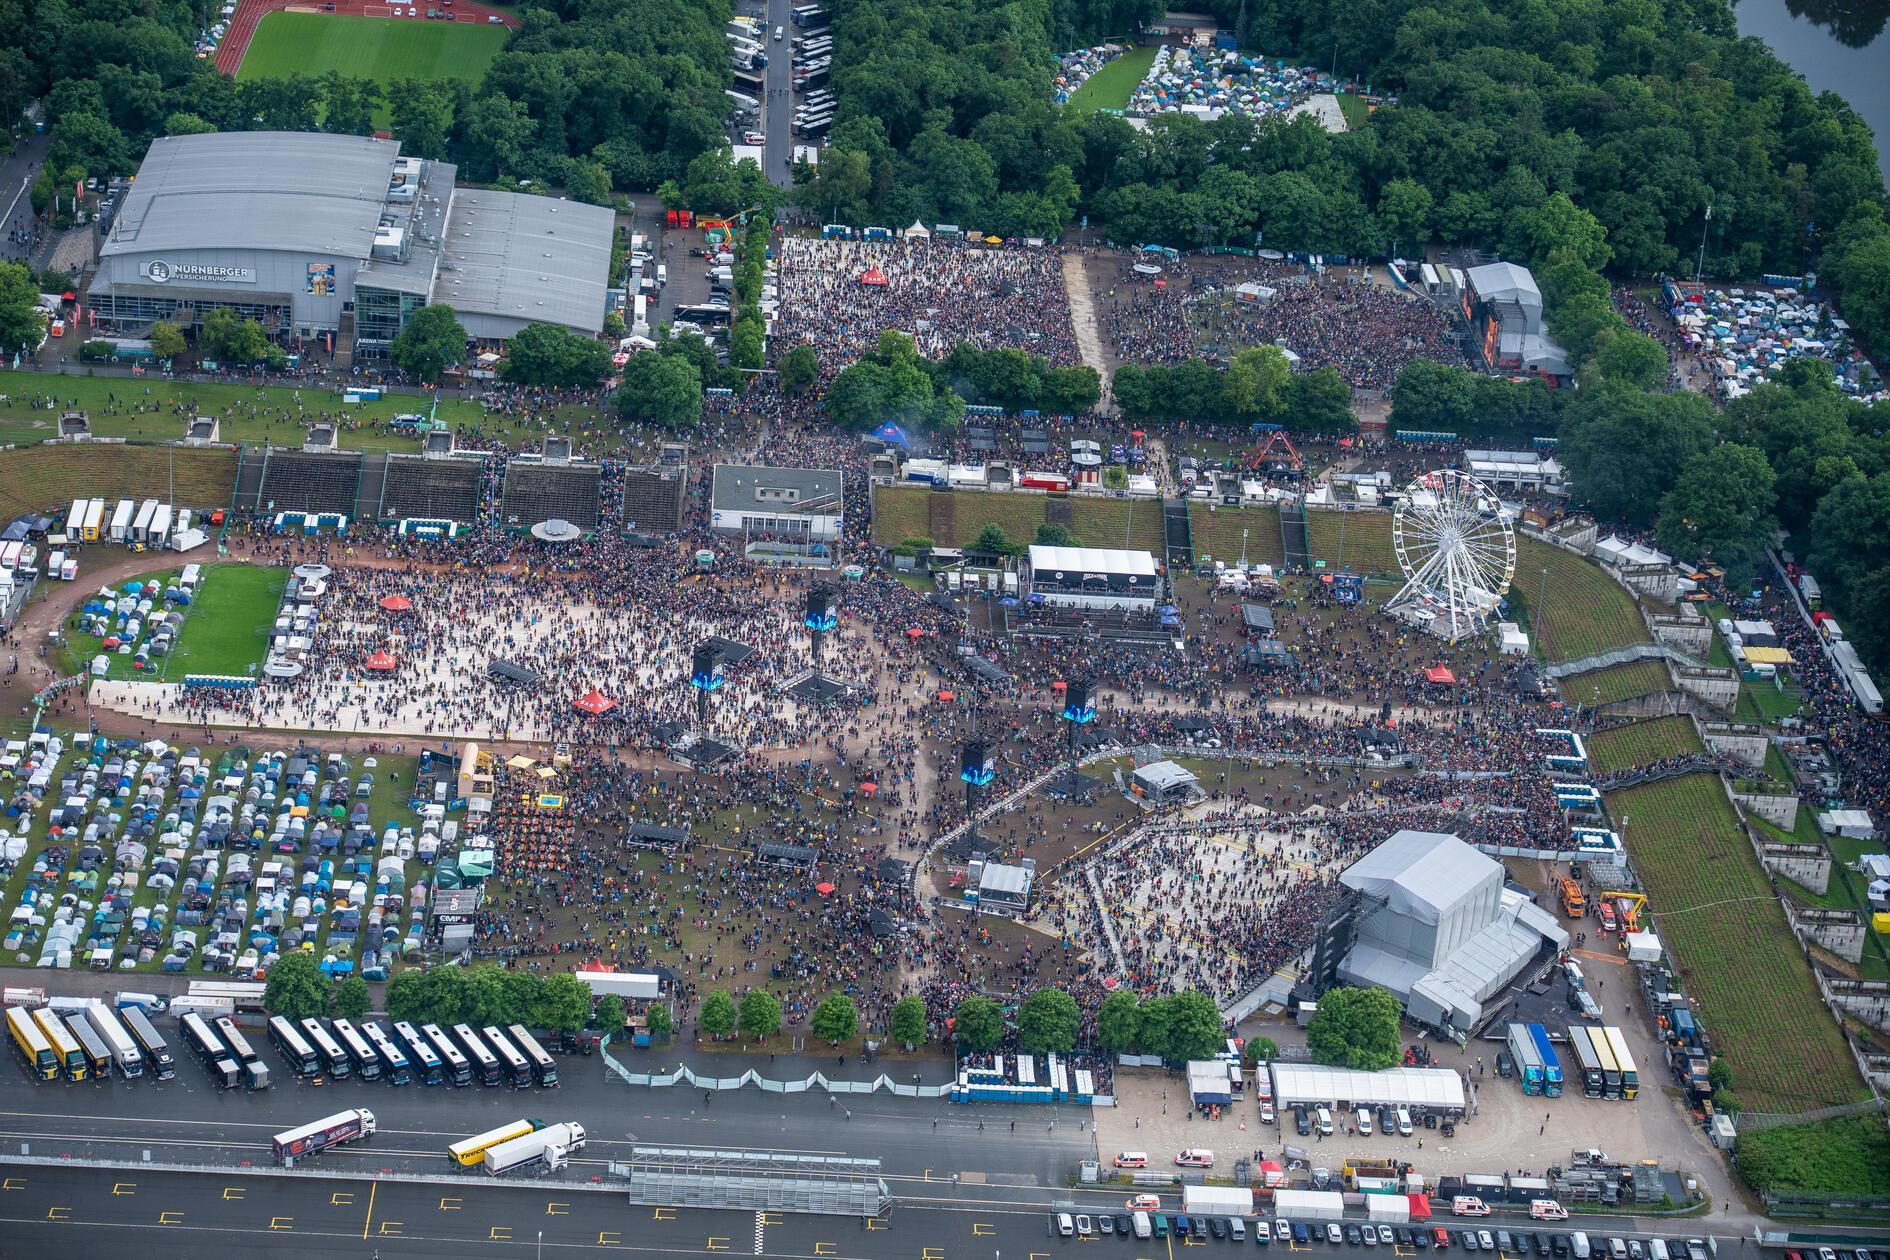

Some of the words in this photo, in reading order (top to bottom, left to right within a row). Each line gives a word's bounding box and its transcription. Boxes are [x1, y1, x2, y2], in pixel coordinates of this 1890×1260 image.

[174, 264, 248, 276] NÜRNBERGER
[175, 273, 228, 282] VERSICHERUNG
[356, 338, 378, 347] ARENA
[580, 699, 595, 708] BAR
